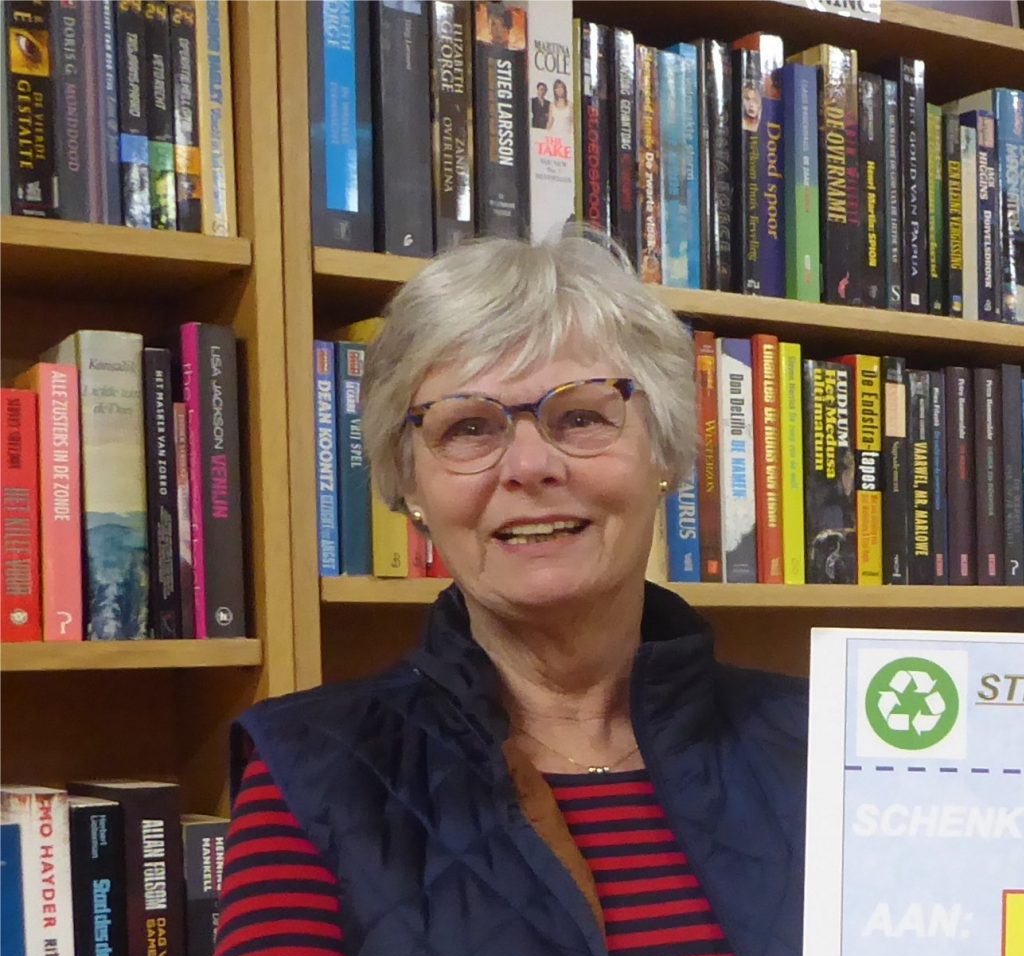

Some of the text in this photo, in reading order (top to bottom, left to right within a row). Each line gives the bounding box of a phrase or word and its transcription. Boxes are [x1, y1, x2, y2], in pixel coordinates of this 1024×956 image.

[63, 17, 76, 60] DORIS
[438, 20, 454, 92] GEORGE
[452, 23, 464, 94] ELIZABETH
[534, 51, 571, 76] COLE
[17, 79, 35, 169] GESTALTE
[64, 82, 80, 171] MONDDOOD
[496, 59, 514, 166] STIEG LARSSON
[442, 116, 454, 193] OVER ELENA
[536, 143, 571, 160] TAKE
[645, 152, 656, 169] De
[827, 107, 846, 223] DE OVERNAME
[866, 160, 876, 189] Henri
[979, 151, 989, 201] HIGGINS
[986, 167, 996, 188] JACK
[763, 122, 783, 240] Dood spoor
[908, 96, 920, 277] HET GOUD VAN PAPUA
[867, 232, 878, 267] SPION
[155, 370, 165, 389] HET
[209, 346, 225, 450] LISA JACKSON
[861, 369, 878, 387] De
[156, 392, 166, 434] MASKER
[317, 380, 334, 491] DEAN KOONTZ
[730, 373, 747, 497] Don DeLillo DE NAMEN
[813, 368, 826, 471] ultimatum
[824, 370, 838, 479] Het Medusa
[837, 370, 849, 448] LUDLUM
[861, 391, 879, 450] Endstra-
[52, 371, 71, 521] ALLE ZUSTERS IN DE ZONDE
[157, 435, 166, 458] VAN
[350, 443, 362, 468] SPEL
[704, 419, 716, 493] WESTERZON
[913, 442, 928, 488] VAARWEL,
[157, 460, 168, 496] ZORRO
[210, 453, 228, 518] VENIJN
[914, 489, 928, 508] MR.
[915, 509, 929, 556] MARLOWE
[38, 806, 57, 928] MO HAYDER
[141, 819, 168, 910] ALLAN FOLSOM
[202, 837, 212, 892] MANKELL
[93, 879, 112, 913] Stad
[862, 902, 974, 939] AAN:
[94, 914, 111, 942] des
[156, 918, 168, 946] DAG
